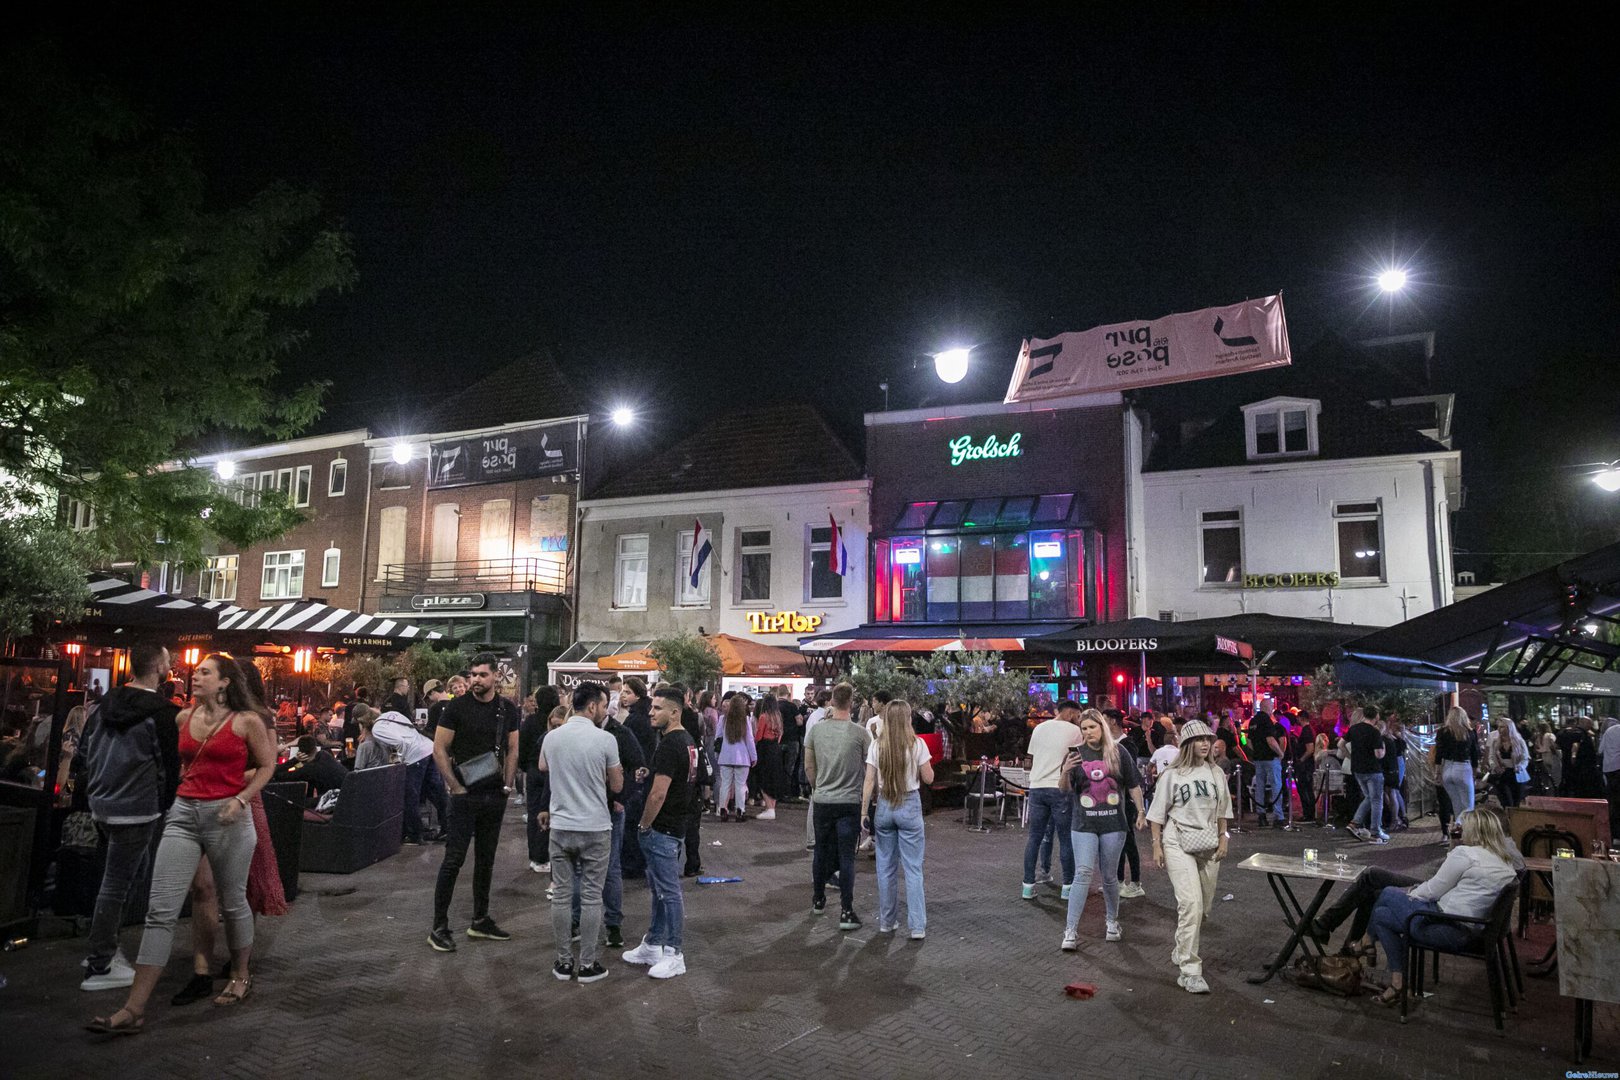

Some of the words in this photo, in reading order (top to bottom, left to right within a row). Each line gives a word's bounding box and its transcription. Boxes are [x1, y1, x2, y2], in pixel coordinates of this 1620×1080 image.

[949, 433, 1021, 465] Grolsch
[1242, 572, 1339, 588] BLOOPERS
[423, 596, 472, 607] plaza
[363, 638, 392, 646] ARNHEM
[1077, 638, 1157, 651] BLOOPERS
[1216, 637, 1238, 655] BLOOPERS
